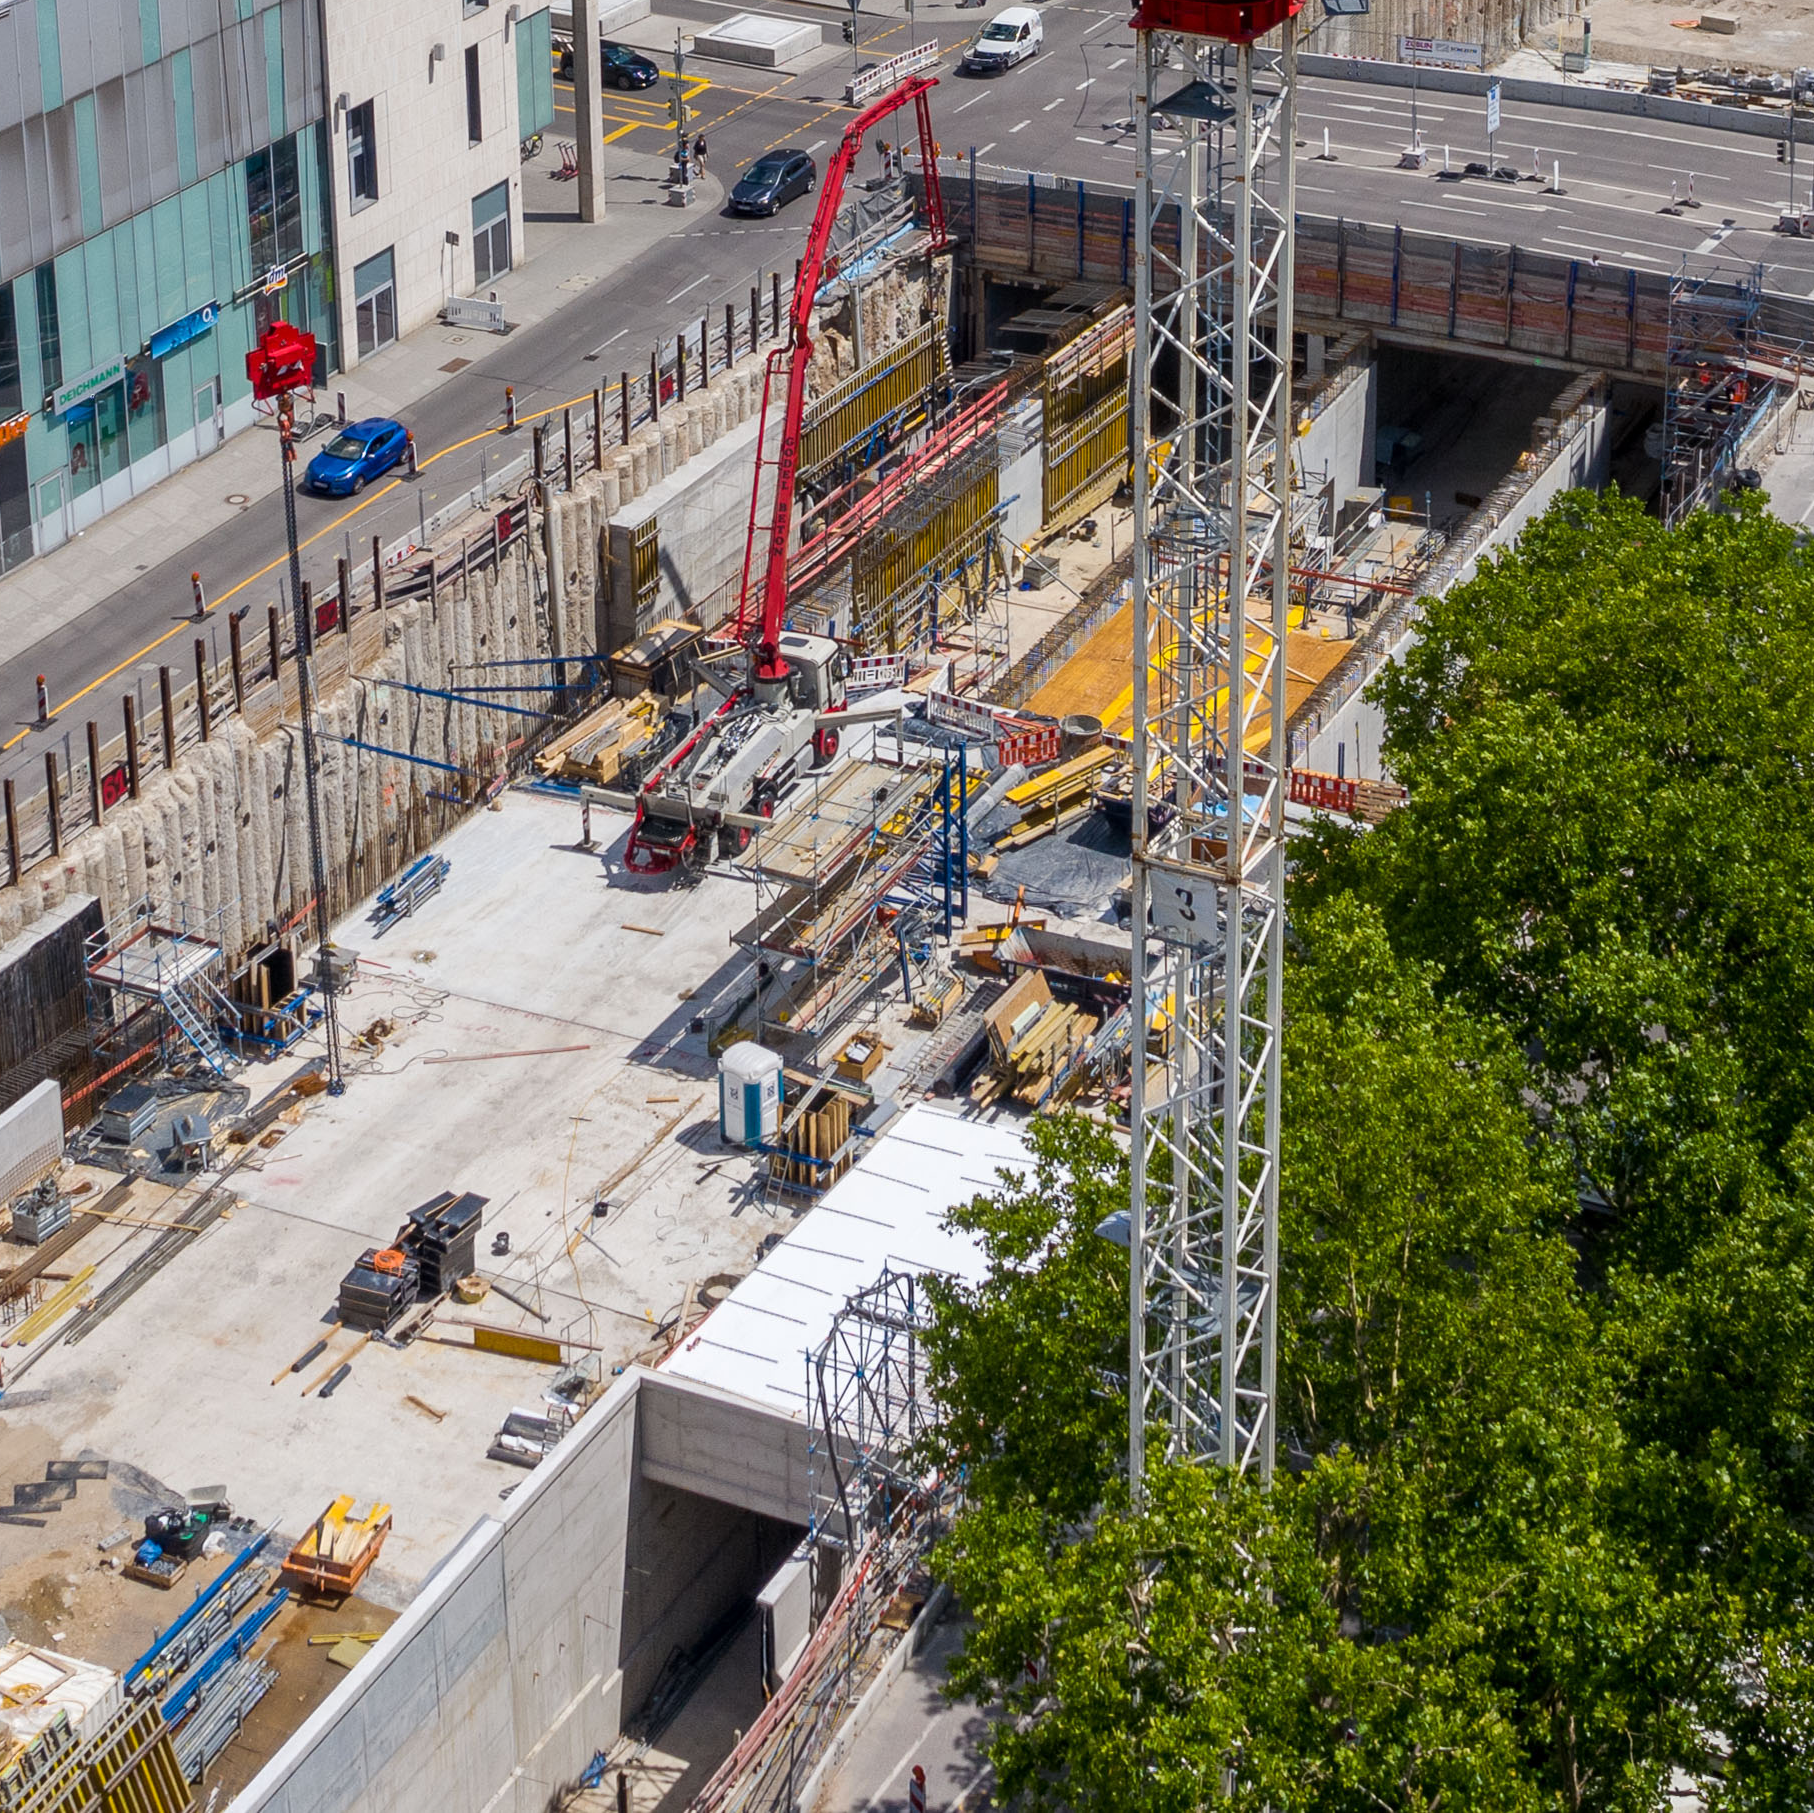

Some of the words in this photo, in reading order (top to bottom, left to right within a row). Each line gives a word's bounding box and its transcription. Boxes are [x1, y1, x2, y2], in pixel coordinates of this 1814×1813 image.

[268, 267, 285, 283] dm
[59, 363, 121, 406] DEICHMANN
[102, 767, 129, 806] 61
[1174, 887, 1197, 921] 3
